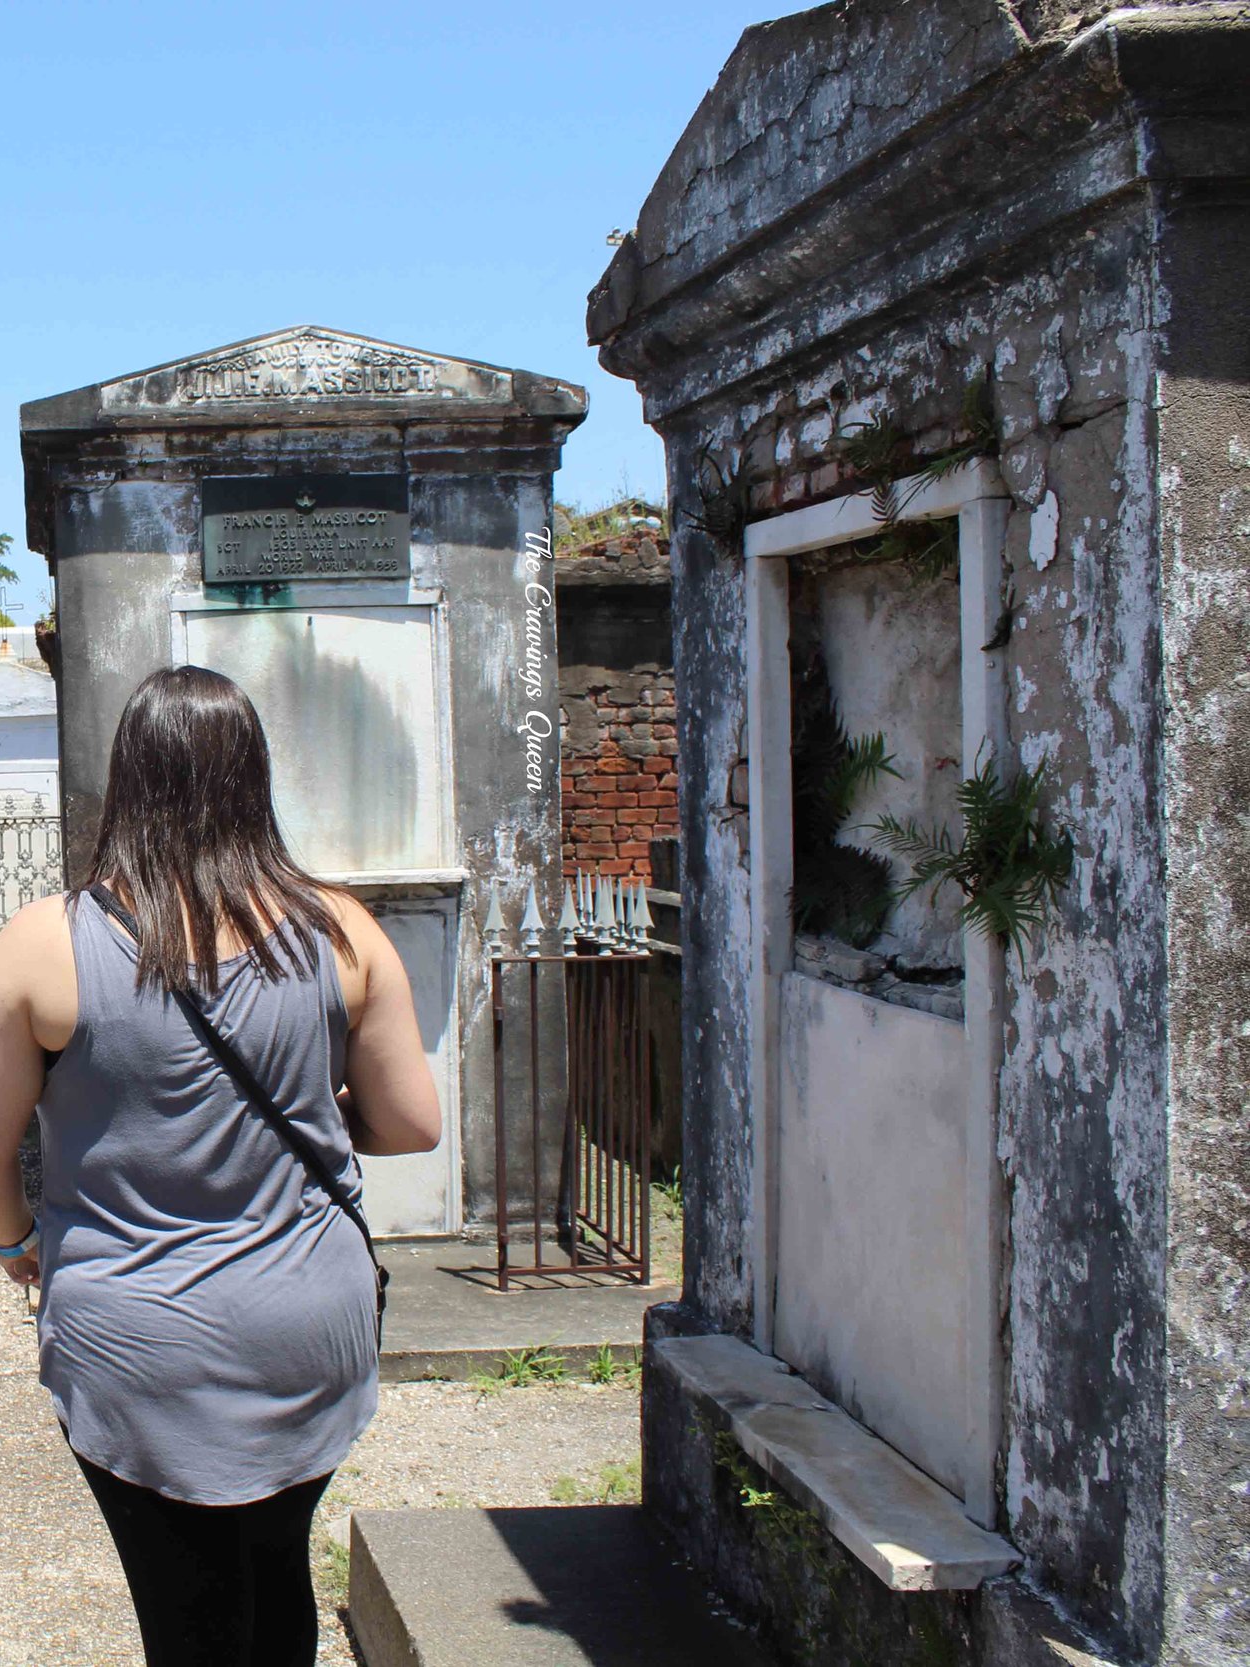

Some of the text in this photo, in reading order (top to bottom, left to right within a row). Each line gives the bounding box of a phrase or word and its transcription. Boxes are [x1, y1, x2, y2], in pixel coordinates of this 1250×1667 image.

[245, 342, 309, 369] FAMILY
[223, 511, 388, 529] FRANCIS E MASSICOT
[272, 526, 339, 540] LOUISIANA
[338, 537, 368, 550] UNIT
[372, 536, 397, 549] AAF
[261, 551, 303, 563] WORLD
[310, 550, 335, 562] WAR
[216, 563, 251, 577] APRIL
[258, 562, 275, 575] 20
[316, 560, 348, 573] APRIL
